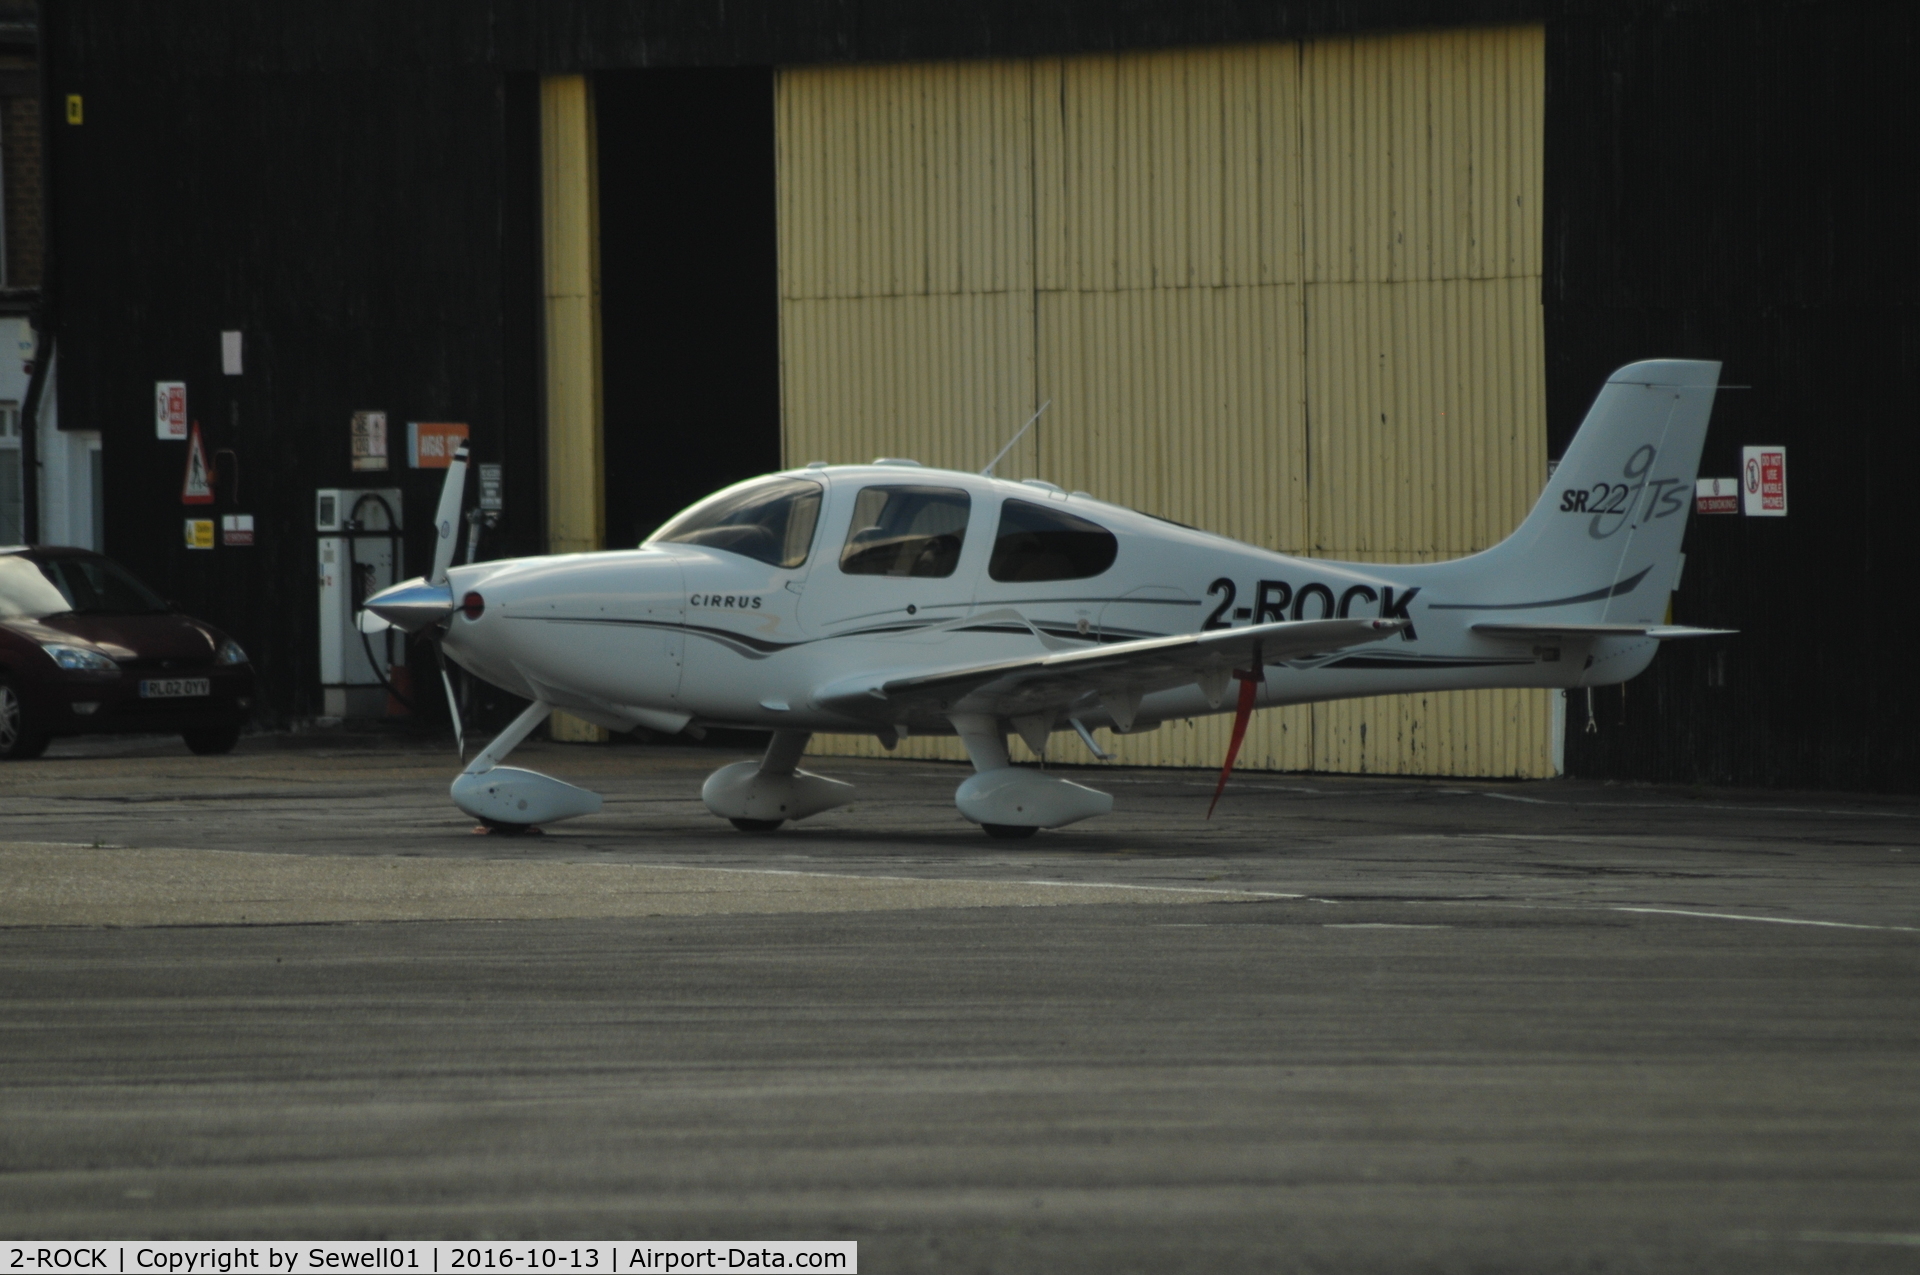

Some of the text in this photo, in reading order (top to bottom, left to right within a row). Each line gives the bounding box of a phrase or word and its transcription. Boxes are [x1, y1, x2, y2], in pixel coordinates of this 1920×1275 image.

[1770, 455, 1782, 466] NOT
[1766, 469, 1778, 481] USE
[1560, 483, 1629, 514] SR22
[1698, 499, 1737, 510] NO SMOKING
[1762, 496, 1783, 508] PHONES
[690, 594, 762, 609] CIRRUS
[1201, 577, 1421, 641] 2-ROCK
[149, 682, 182, 695] RL02
